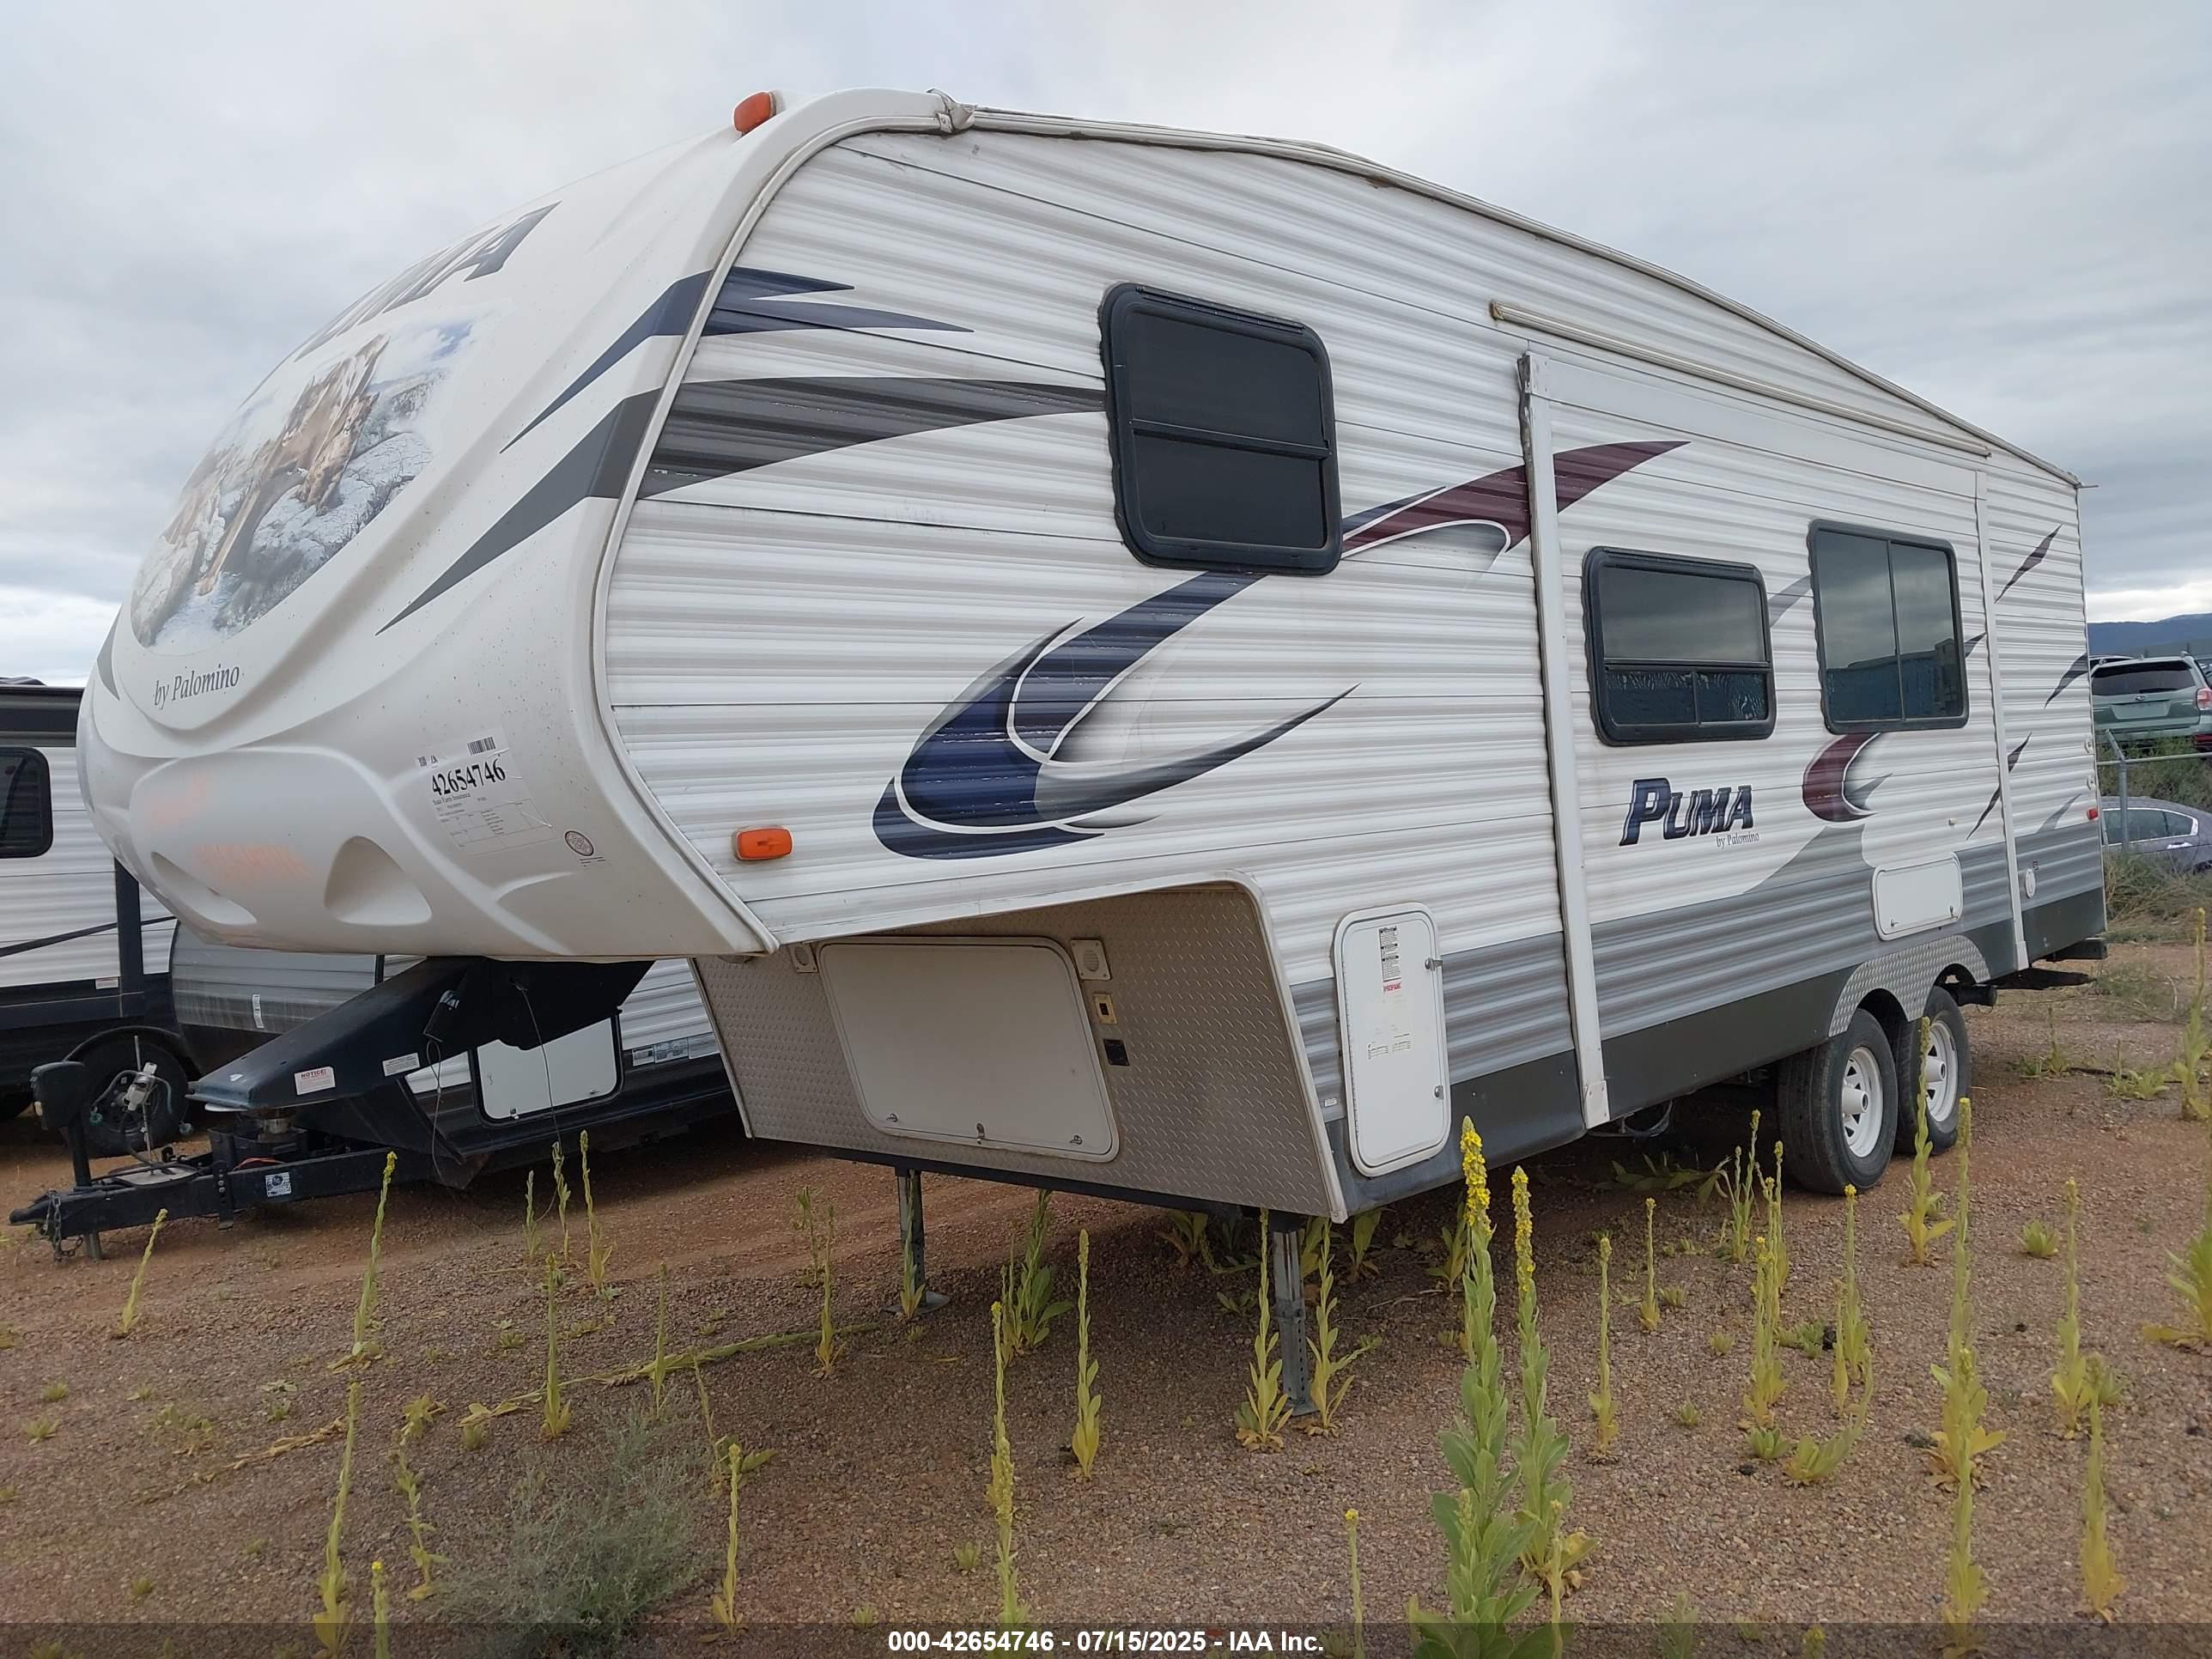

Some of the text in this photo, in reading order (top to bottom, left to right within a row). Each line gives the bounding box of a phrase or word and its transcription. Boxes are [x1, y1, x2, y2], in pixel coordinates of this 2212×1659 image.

[155, 663, 240, 710] by Palomino
[432, 758, 506, 795] 42654746
[1619, 778, 1753, 846] PUMA
[1716, 831, 1759, 848] by Palomino
